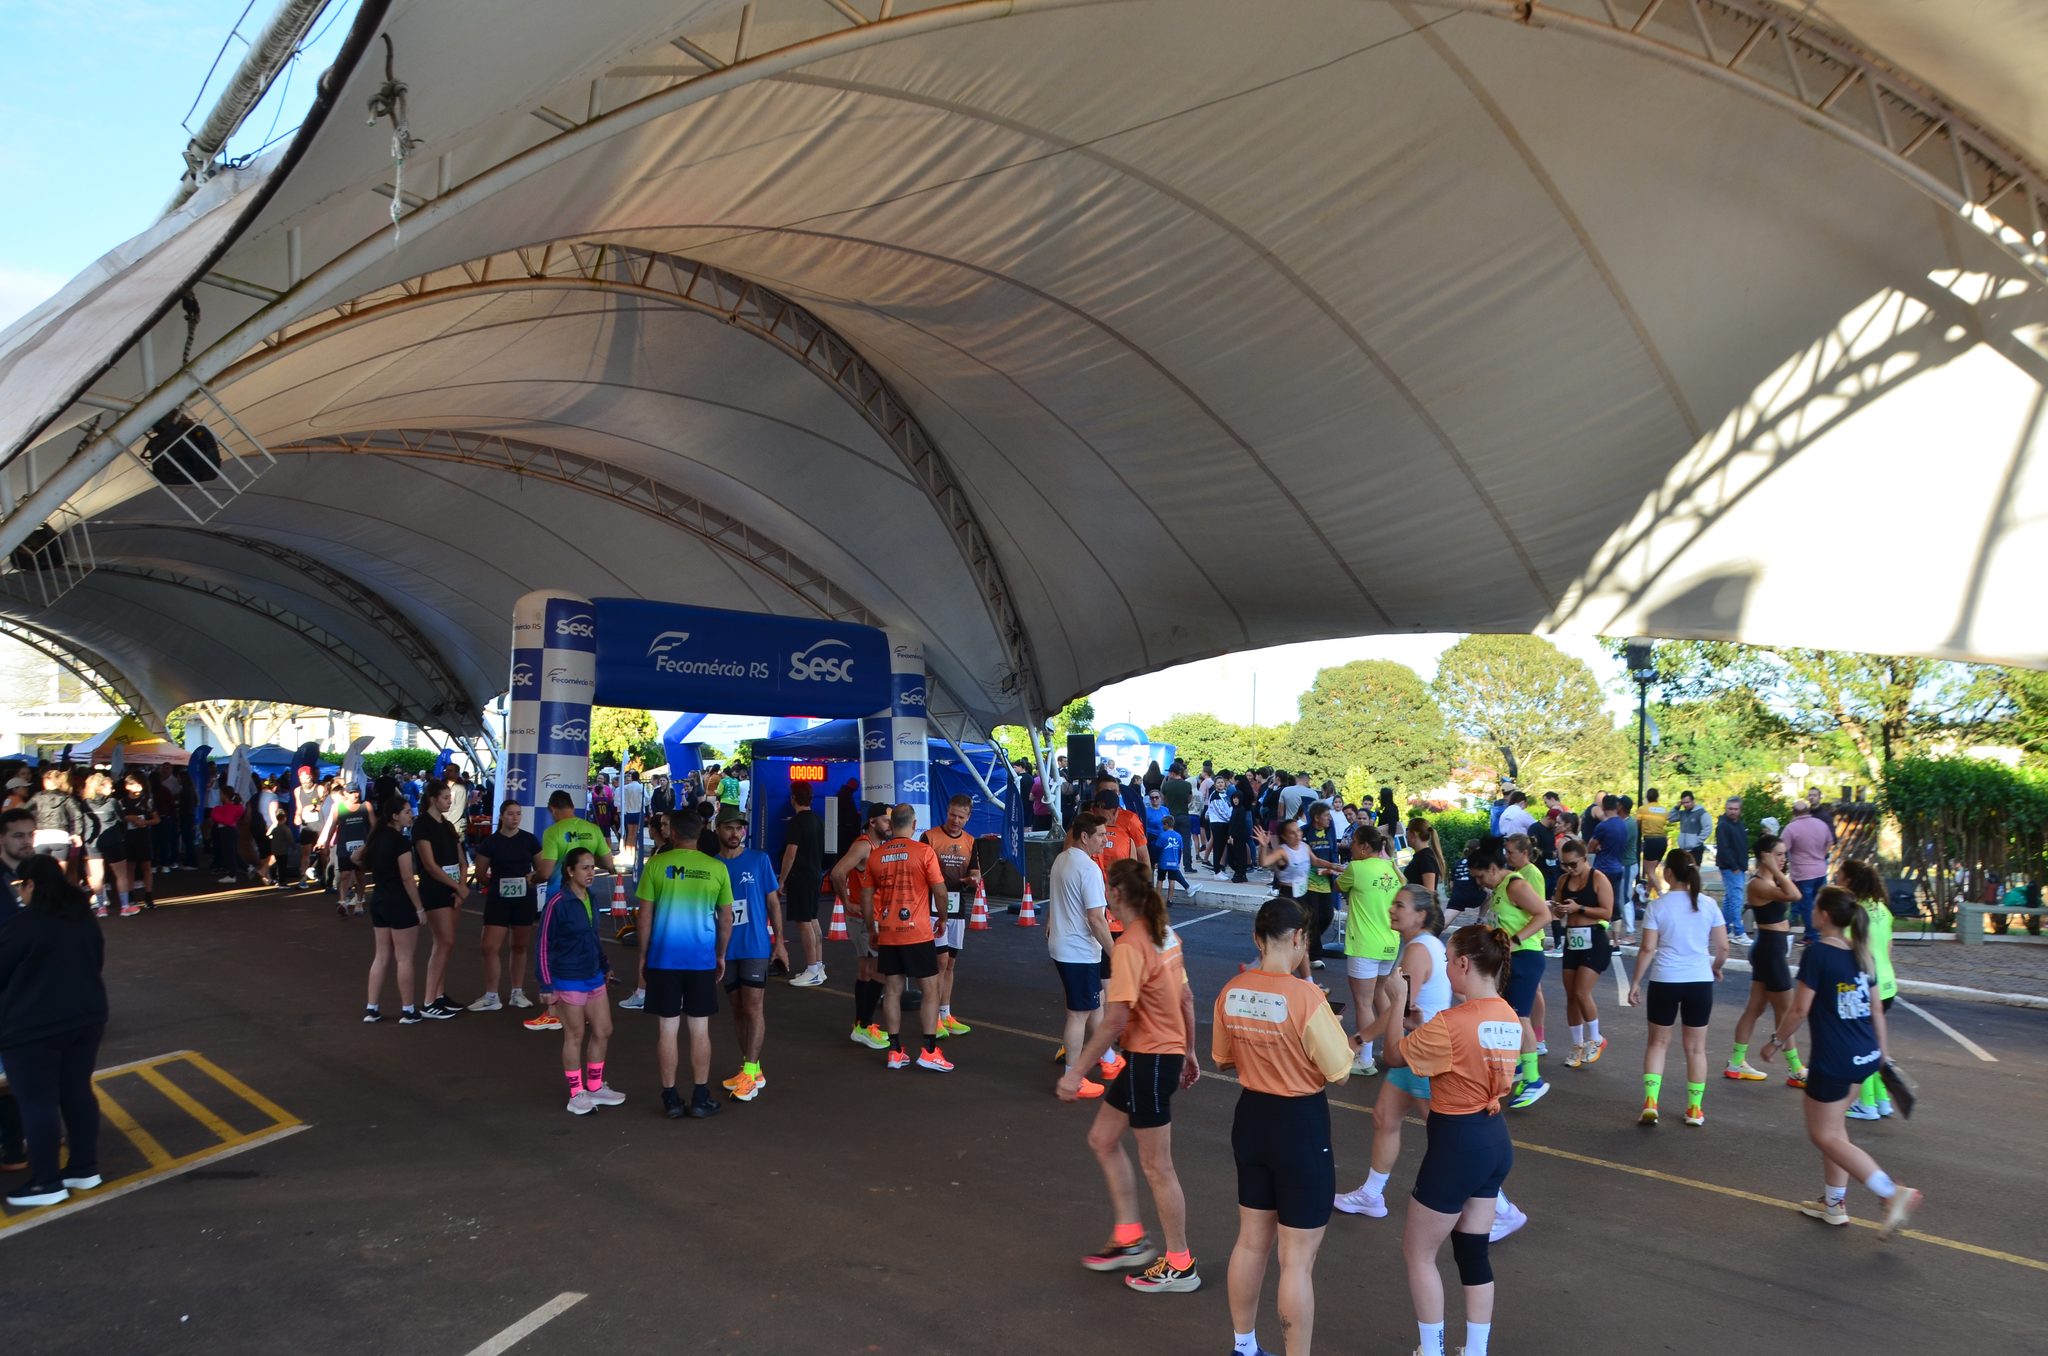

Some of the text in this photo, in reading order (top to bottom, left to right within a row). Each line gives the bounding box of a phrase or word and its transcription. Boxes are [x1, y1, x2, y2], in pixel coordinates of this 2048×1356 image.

[532, 622, 541, 630] RS
[656, 655, 769, 678] Fecomércio RS
[788, 650, 854, 682] Sesc
[512, 672, 533, 686] esc
[525, 728, 536, 736] RS
[864, 737, 886, 751] esc
[505, 777, 527, 791] esc
[503, 884, 523, 896] 231
